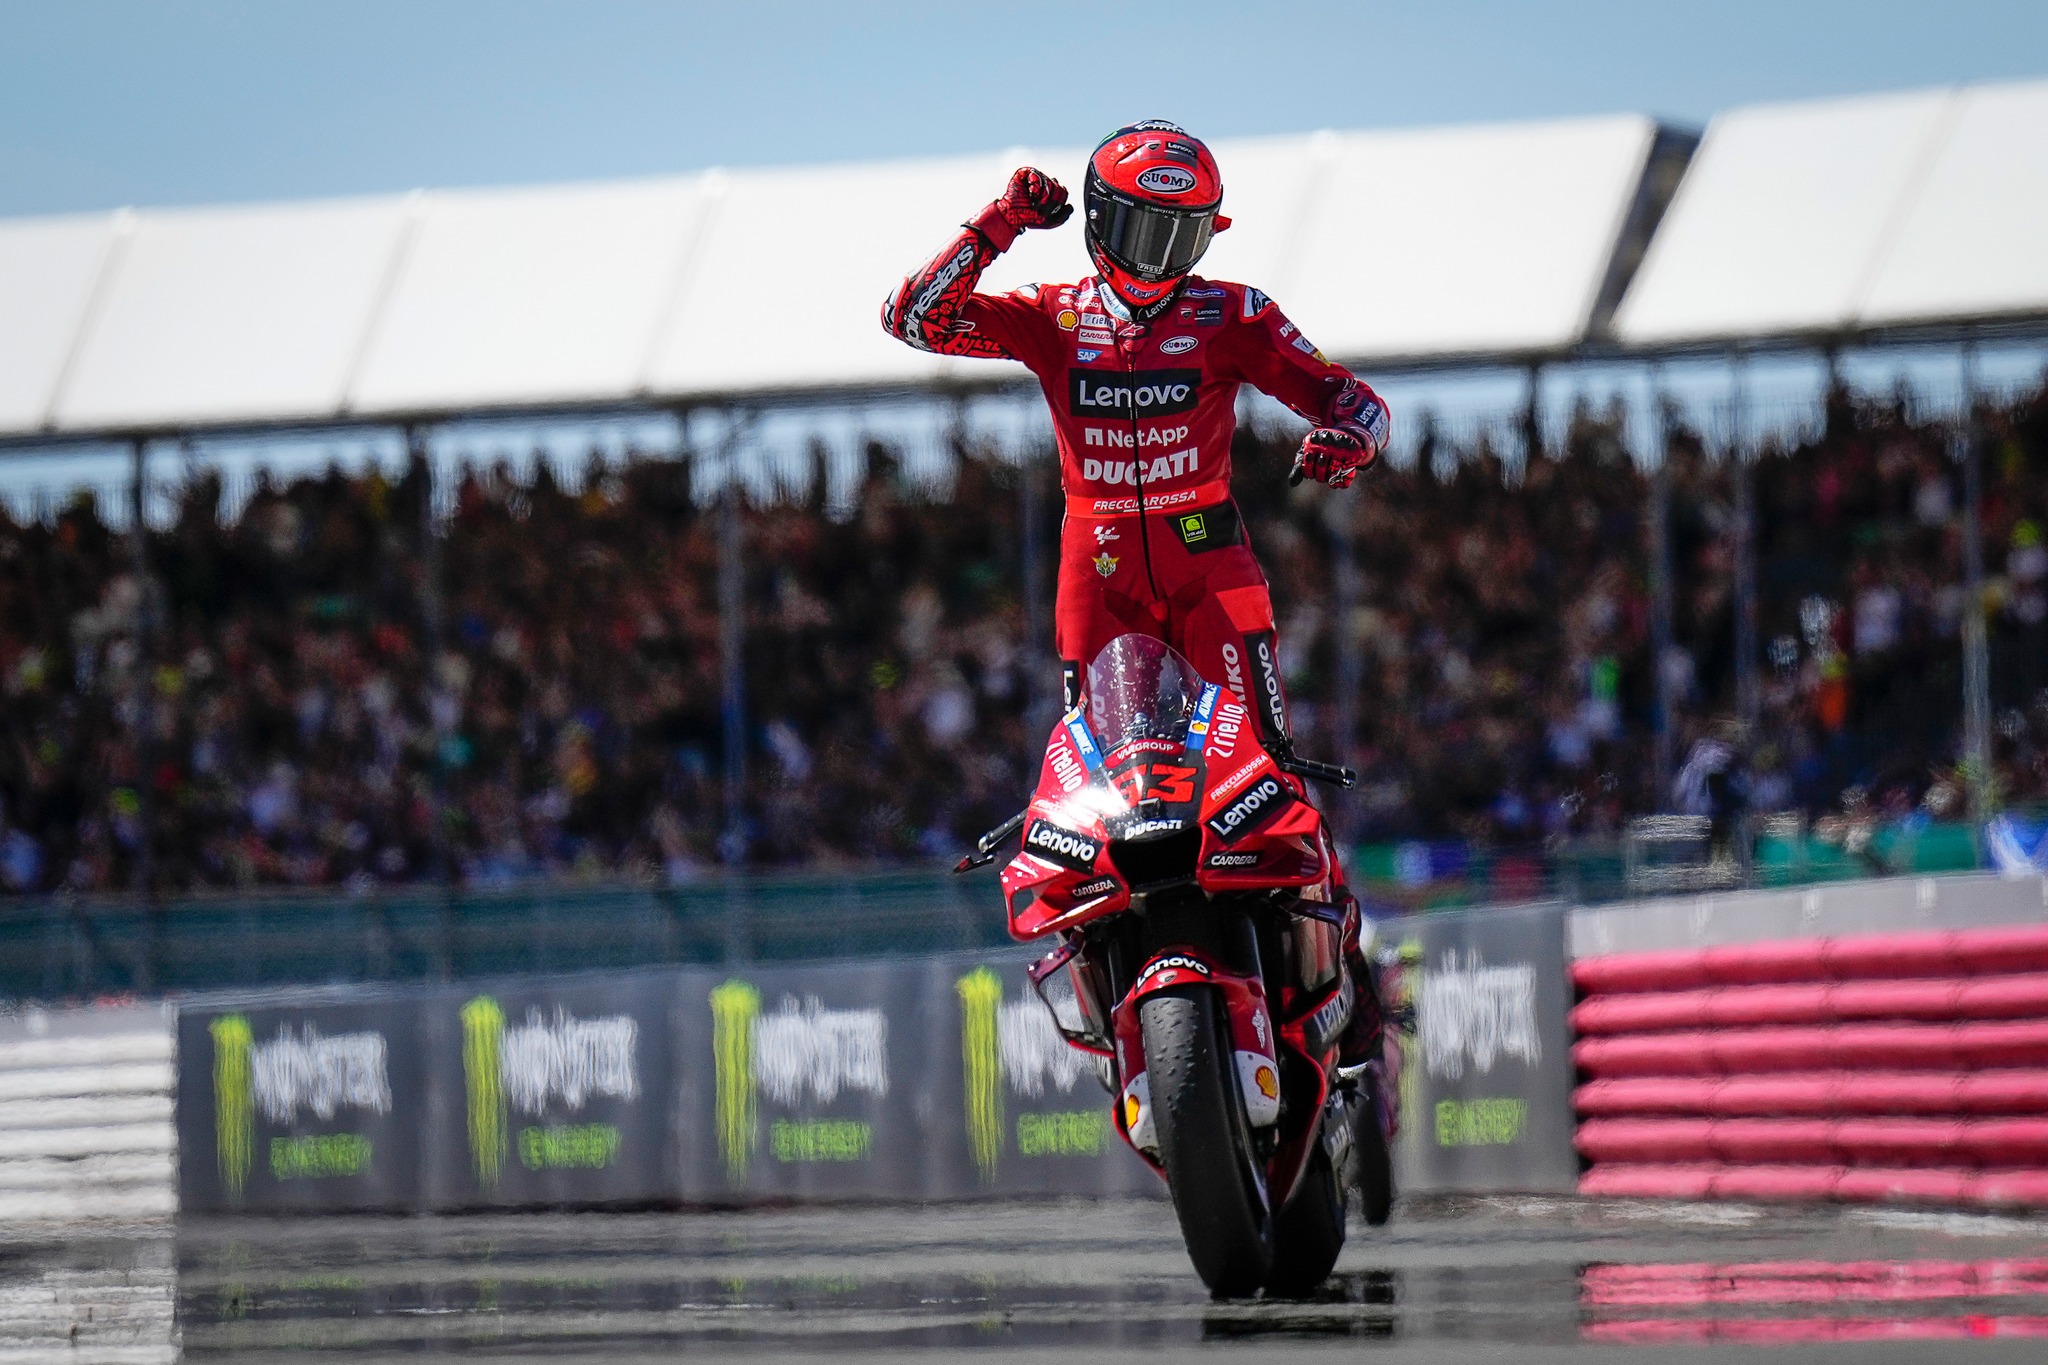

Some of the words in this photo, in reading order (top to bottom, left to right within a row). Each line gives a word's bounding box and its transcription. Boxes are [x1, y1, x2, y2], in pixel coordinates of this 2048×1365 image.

[1143, 172, 1193, 189] SUOMY
[1080, 331, 1114, 340] CARRERA
[1165, 341, 1195, 349] SUOMY
[1077, 351, 1096, 361] SAP
[1079, 380, 1190, 408] Lenovo
[1355, 402, 1377, 425] Lenovo
[1107, 425, 1189, 448] NetApp
[1083, 447, 1199, 486] DUCATI
[1197, 682, 1218, 719] ADVANCE
[1210, 755, 1269, 801] FRECCIAROSSA
[1209, 780, 1279, 836] Lenovo
[1124, 819, 1182, 841] DUCATI
[1028, 823, 1095, 862] Lenovo
[1210, 854, 1258, 866] CARRERA
[1072, 879, 1115, 897] CARRERA
[1136, 956, 1209, 985] Lenovo
